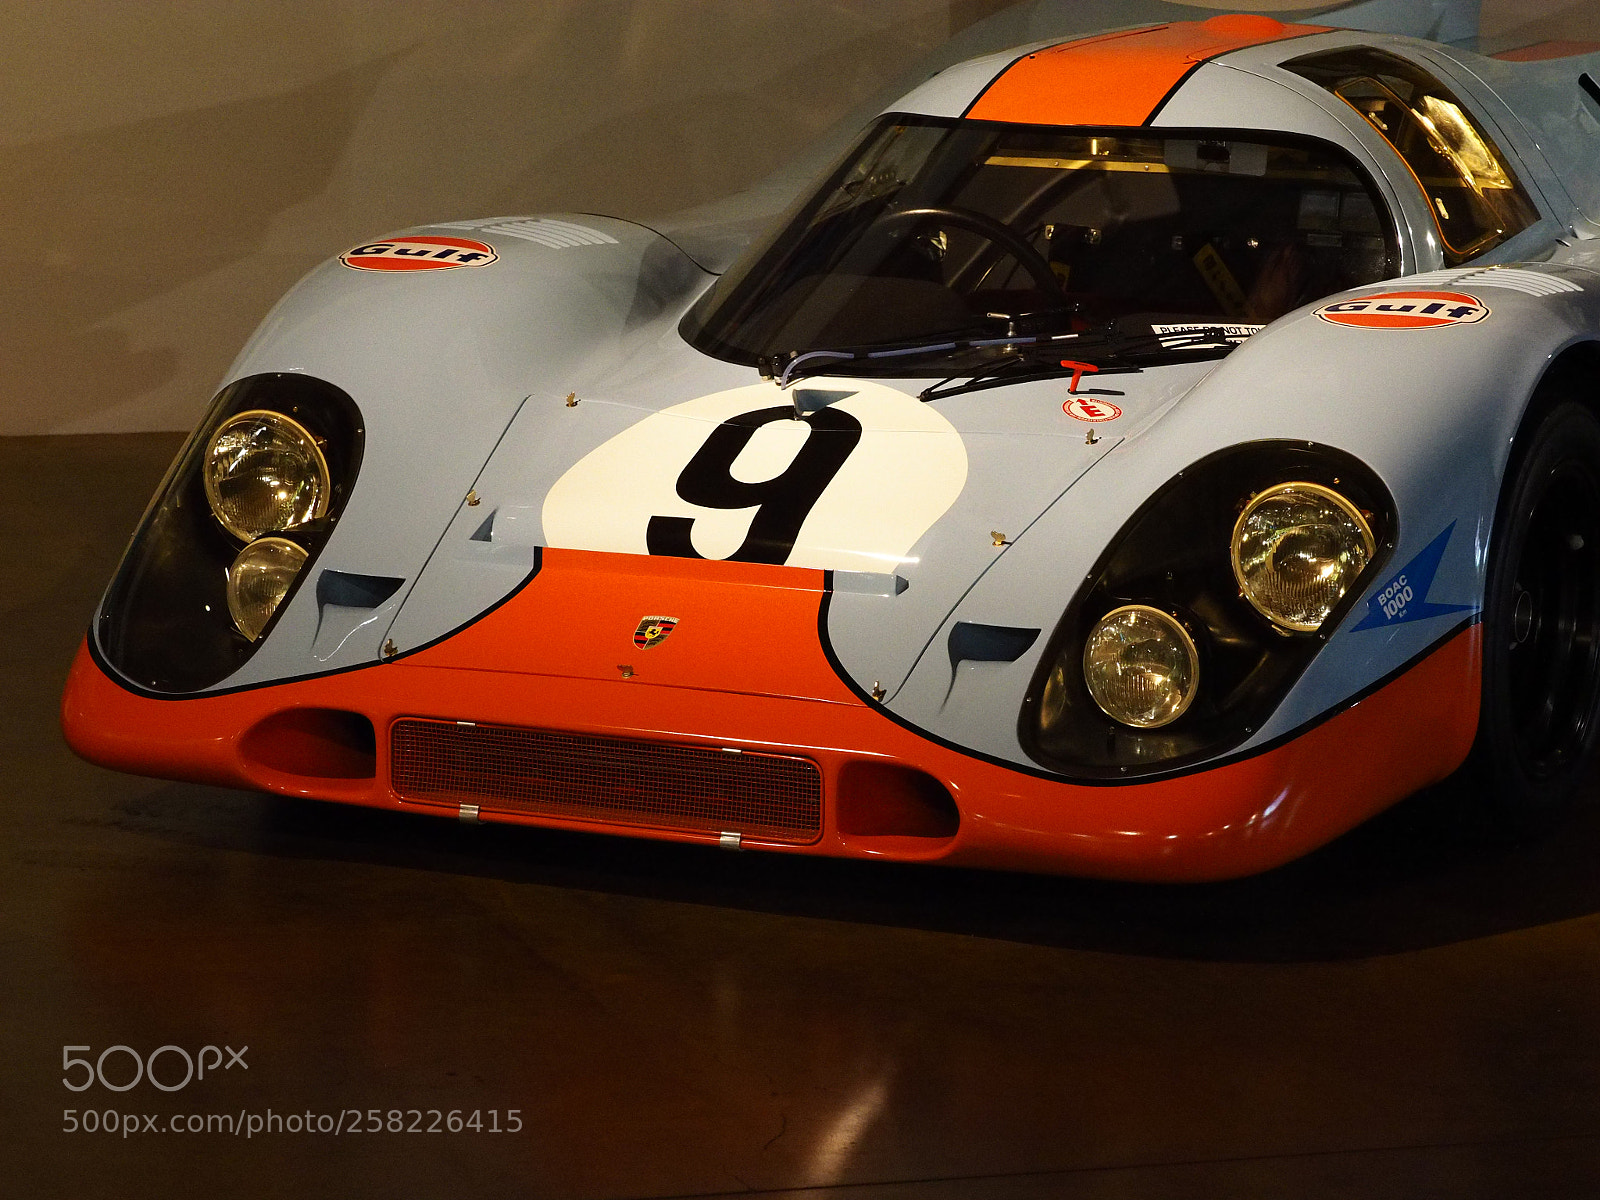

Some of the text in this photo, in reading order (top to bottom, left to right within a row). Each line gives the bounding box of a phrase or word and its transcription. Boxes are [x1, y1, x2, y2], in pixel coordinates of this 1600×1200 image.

[350, 243, 489, 263] Gulf
[1324, 301, 1480, 319] Gulf
[1223, 326, 1242, 336] NOT
[1245, 327, 1261, 336] TO
[646, 405, 862, 565] 9
[1377, 575, 1408, 606] BOAC
[1383, 586, 1414, 620] 1000
[642, 615, 680, 624] PORSCHE
